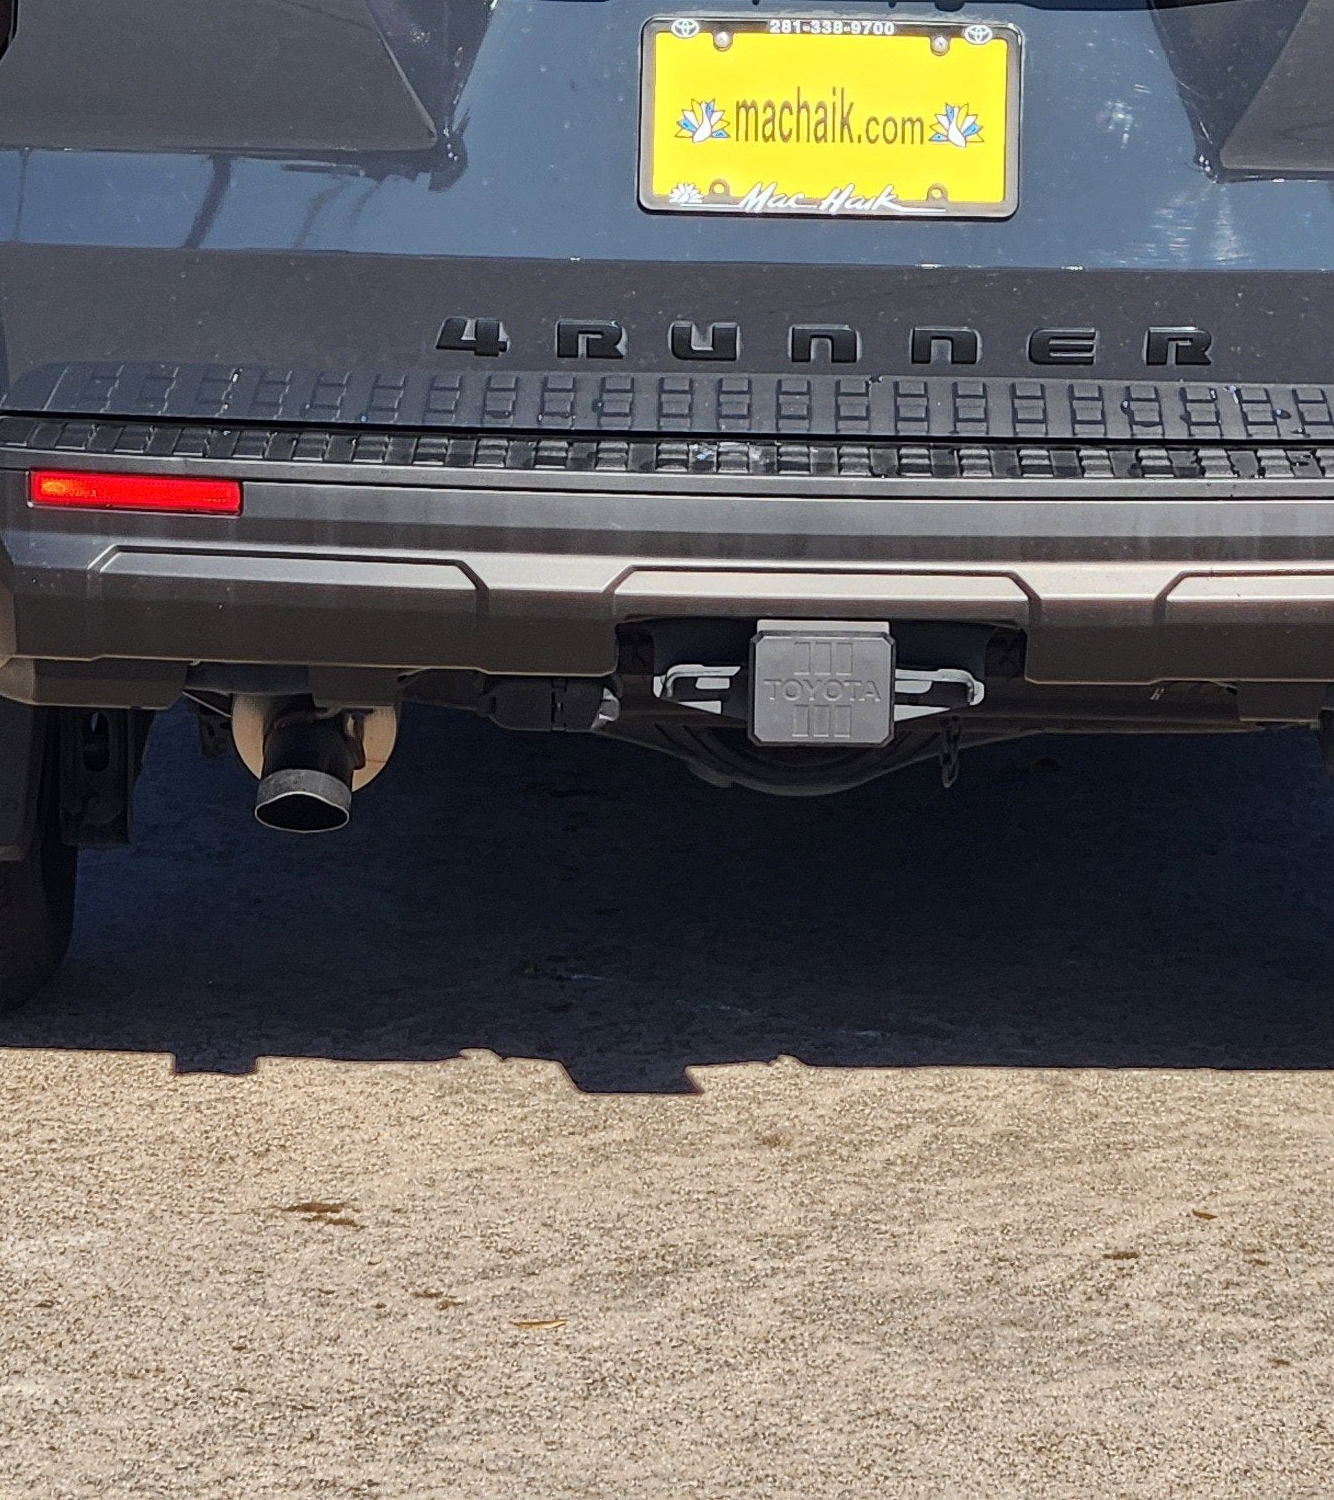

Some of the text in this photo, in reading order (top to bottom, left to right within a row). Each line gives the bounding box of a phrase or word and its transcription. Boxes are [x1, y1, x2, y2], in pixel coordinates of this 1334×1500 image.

[769, 19, 895, 36] 281-338-9700
[734, 86, 925, 145] machaik.com
[736, 181, 907, 215] Mac Haik
[435, 316, 1214, 368] 4RUNNER
[763, 677, 882, 703] TOYOTA
